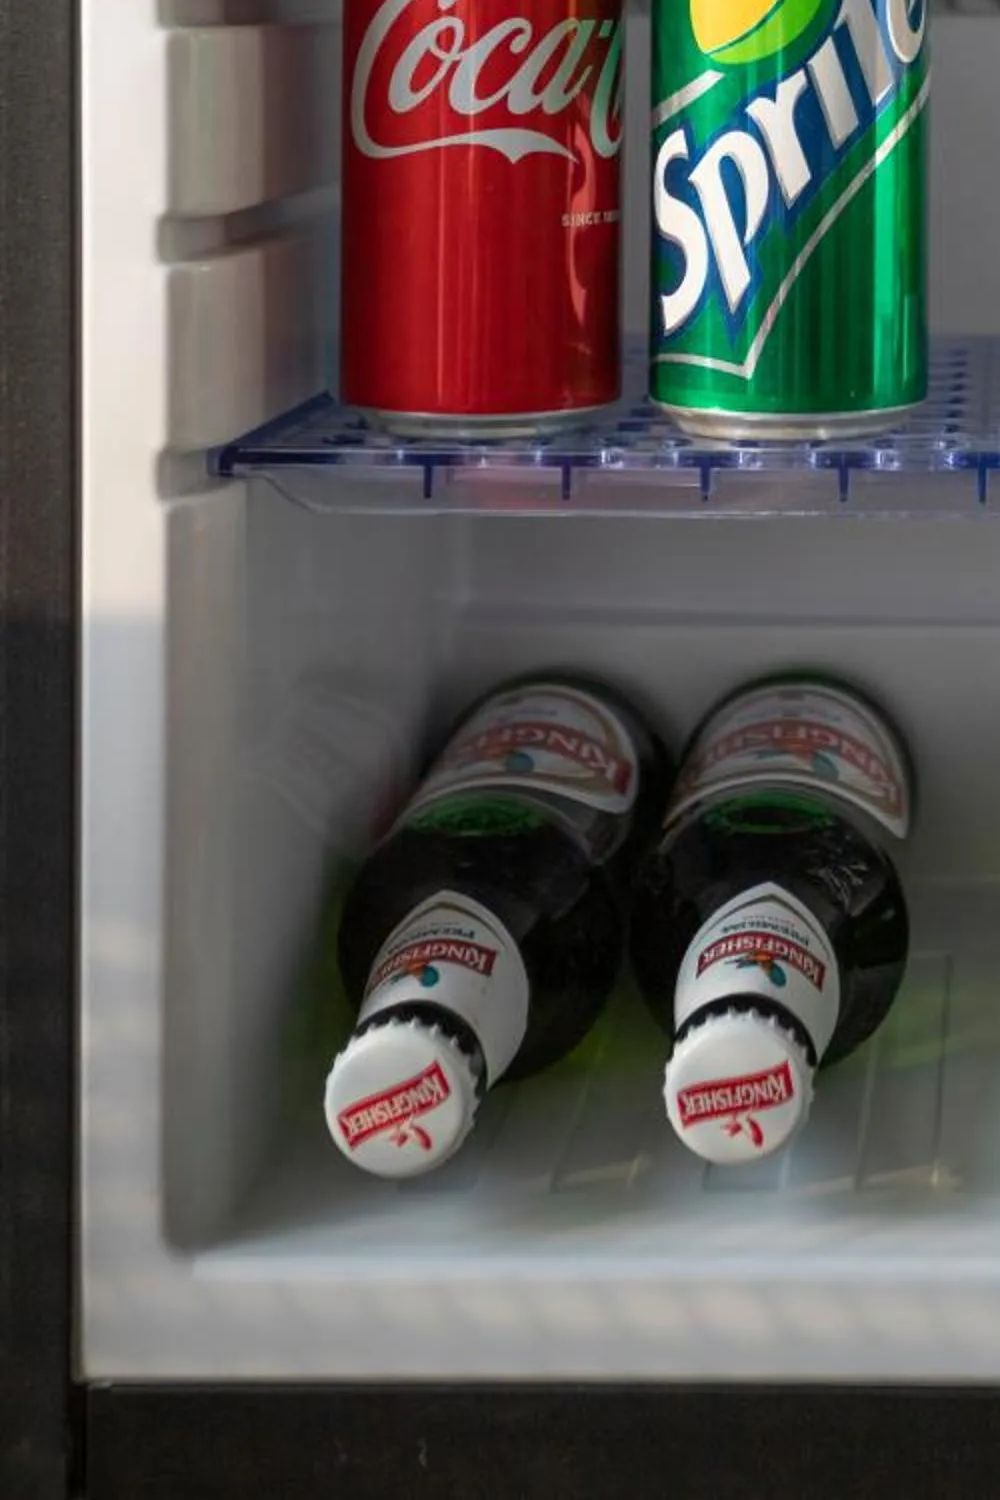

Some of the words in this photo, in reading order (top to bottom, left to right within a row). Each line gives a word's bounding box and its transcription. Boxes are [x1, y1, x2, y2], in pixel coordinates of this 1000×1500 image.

[703, 935, 820, 981] KINGFISHER
[340, 1072, 447, 1137] KINGFISHER
[682, 1072, 788, 1116] KINGFISHER
